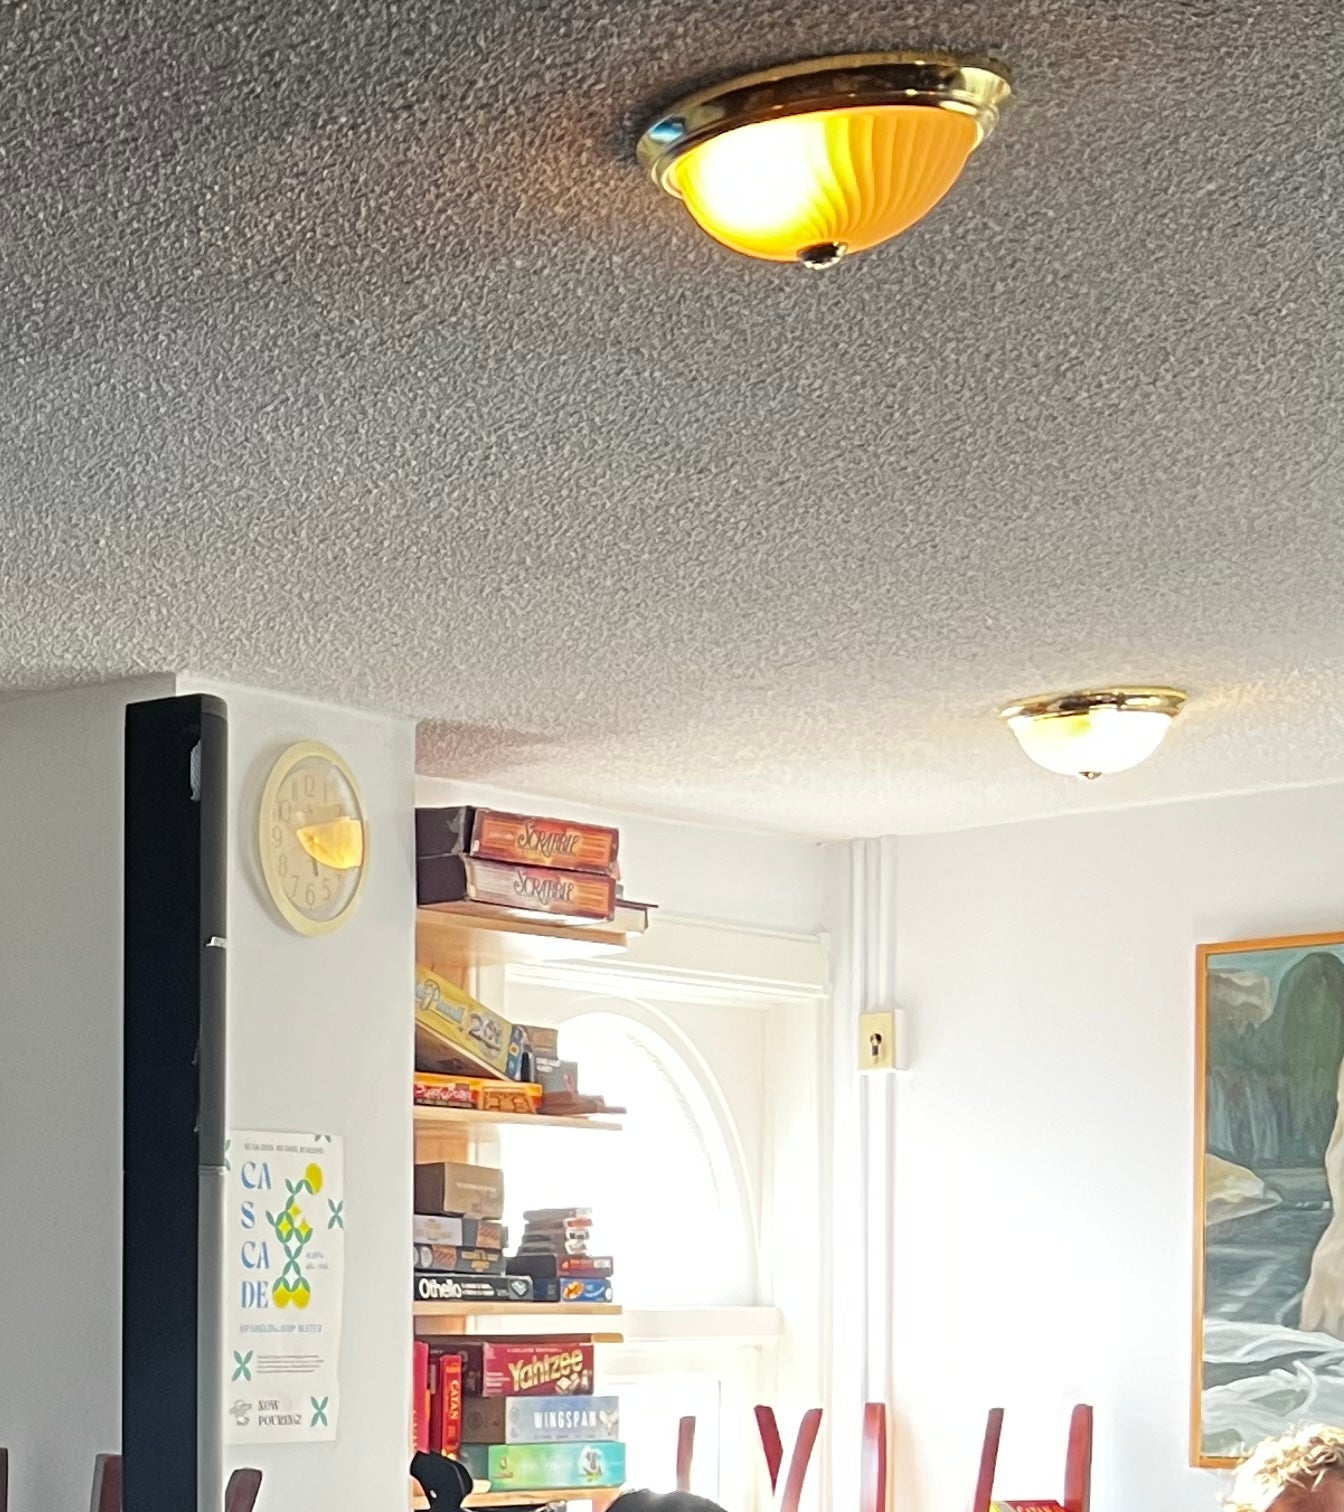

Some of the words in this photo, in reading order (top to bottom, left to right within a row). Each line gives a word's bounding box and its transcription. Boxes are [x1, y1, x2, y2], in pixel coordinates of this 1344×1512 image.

[304, 774, 315, 798] 12
[272, 825, 282, 848] 9
[290, 874, 300, 899] 7
[305, 882, 315, 906] 6
[241, 1160, 272, 1190] CA
[240, 1200, 255, 1229] S
[240, 1240, 270, 1270] CA
[240, 1280, 269, 1309] DE
[418, 1278, 462, 1299] Othello
[508, 1349, 583, 1392] Yahtzee
[450, 1379, 460, 1420] CATAN
[534, 1410, 597, 1429] WINGSPAN
